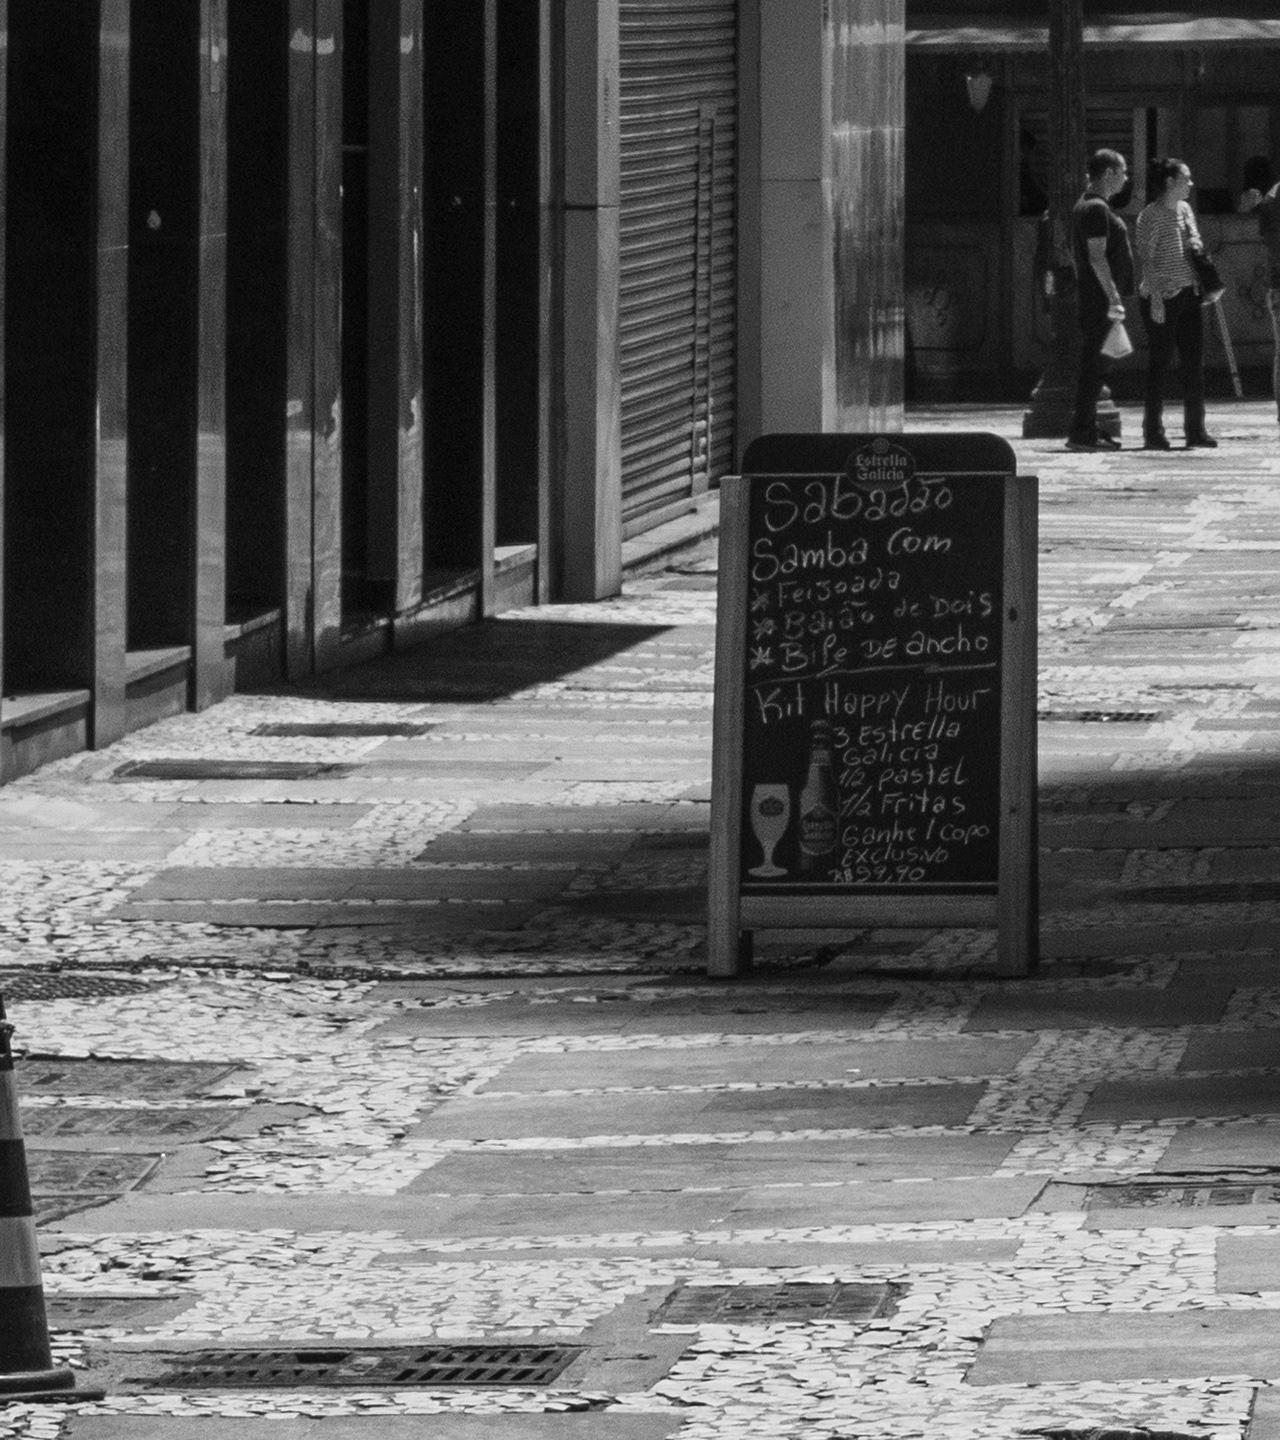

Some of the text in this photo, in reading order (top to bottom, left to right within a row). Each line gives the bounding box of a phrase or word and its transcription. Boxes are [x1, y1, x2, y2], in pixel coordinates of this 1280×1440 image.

[855, 454, 907, 467] Estrella
[856, 468, 905, 481] Galicia
[765, 475, 952, 531] Sabadão
[752, 527, 951, 581] Samba Com
[905, 622, 988, 655] ancho
[755, 681, 803, 724] Kit
[924, 680, 991, 713] Hour
[833, 726, 850, 748] 3
[880, 787, 966, 814] Fritas
[841, 819, 917, 847] Ganhe
